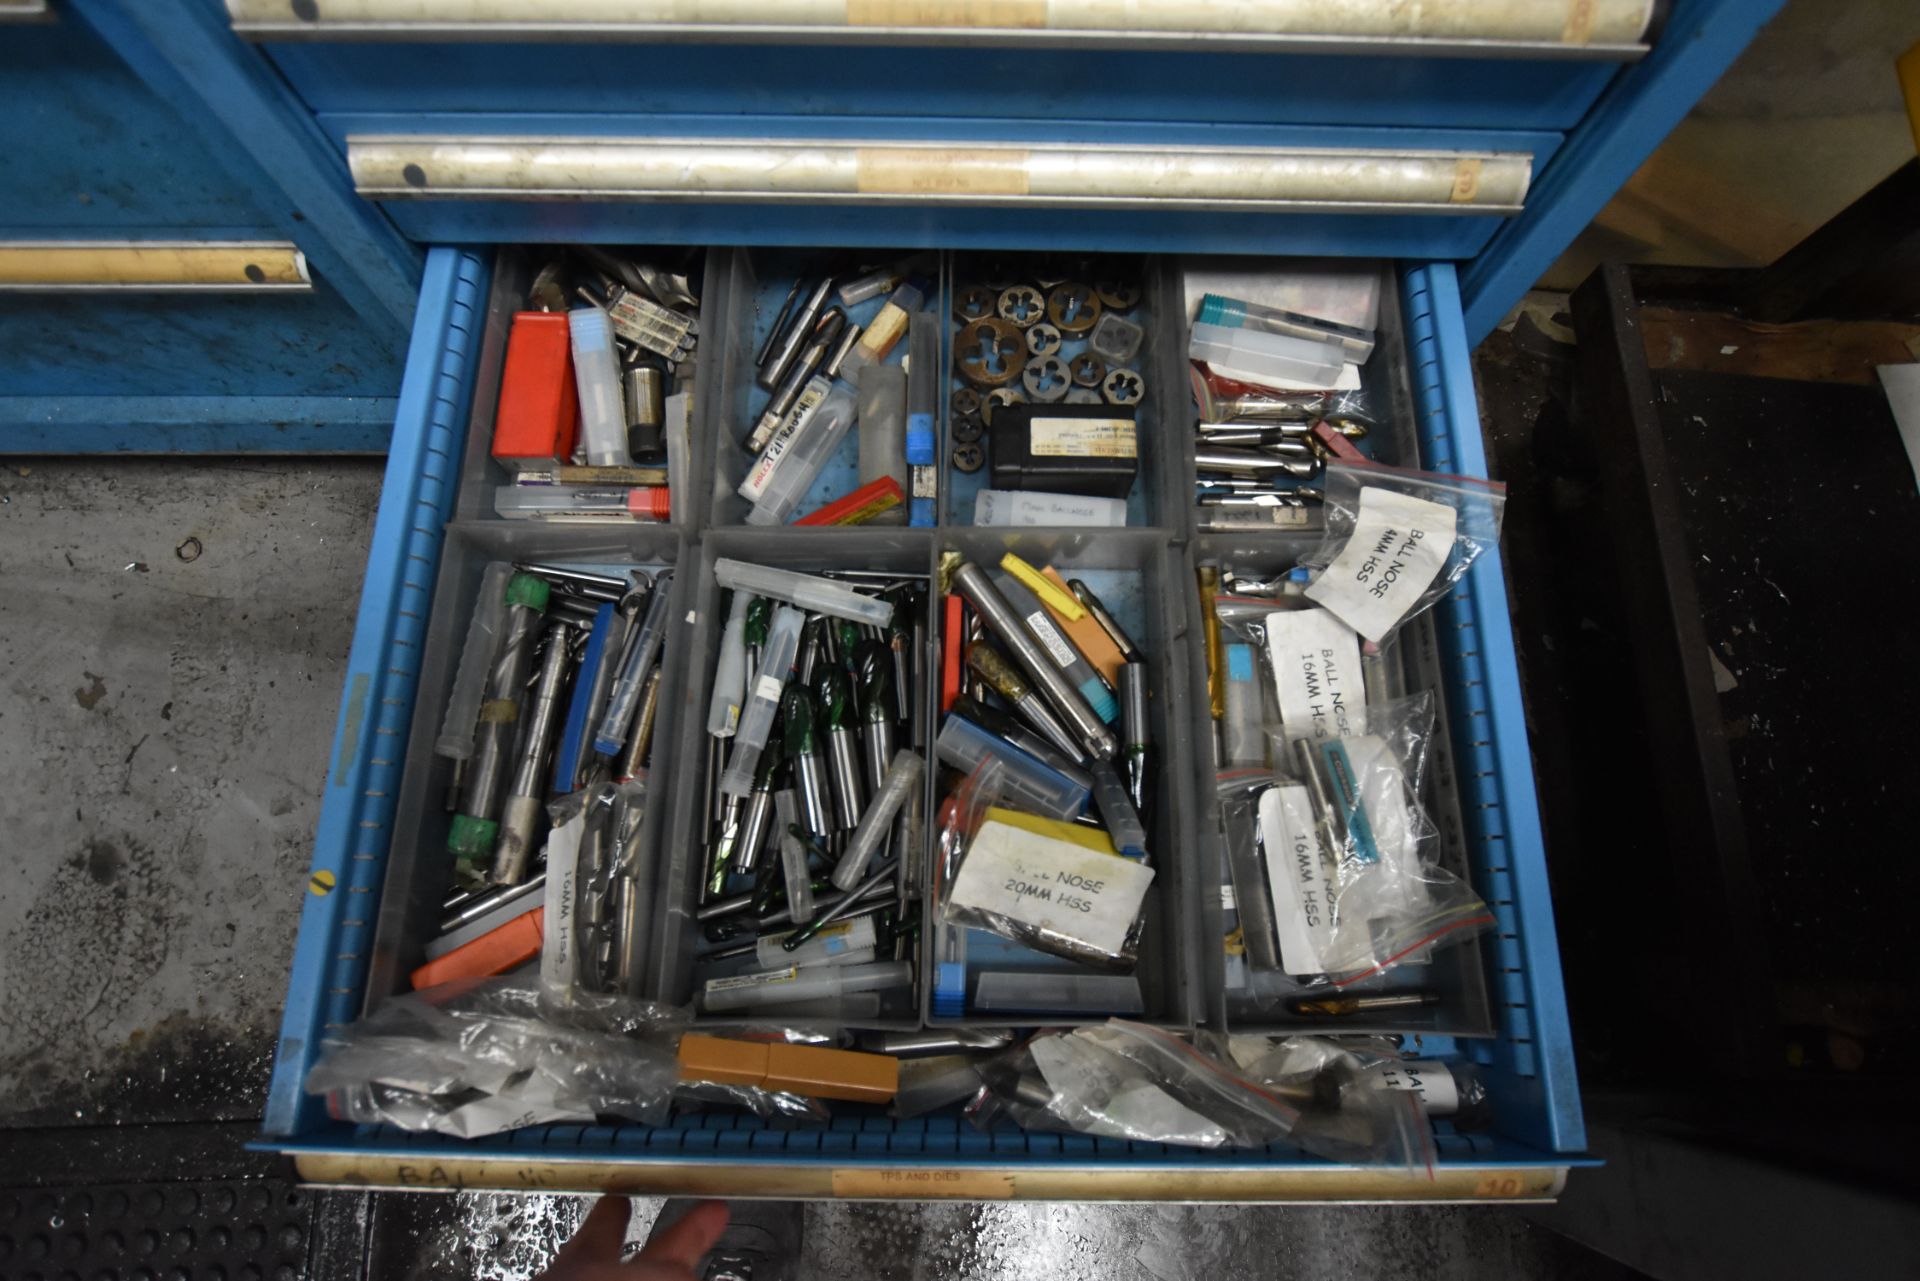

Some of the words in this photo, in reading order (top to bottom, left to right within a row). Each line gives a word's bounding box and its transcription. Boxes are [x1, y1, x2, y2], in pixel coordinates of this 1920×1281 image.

[1374, 528, 1397, 553] 4MM
[1397, 529, 1424, 556] BALL
[1356, 555, 1381, 583] HSS
[1369, 560, 1404, 599] NOSE
[1302, 654, 1321, 698] 16MM
[1322, 649, 1338, 686] BALL
[1331, 692, 1351, 737] NOSE
[1294, 836, 1314, 882] 16MM
[560, 871, 573, 919] 16MM
[1005, 878, 1052, 901] 20MM
[1057, 892, 1093, 913] HSS
[1056, 871, 1104, 894] NOSE
[1303, 891, 1321, 927] HSS
[906, 1172, 930, 1182] AND
[934, 1172, 960, 1182] DIES
